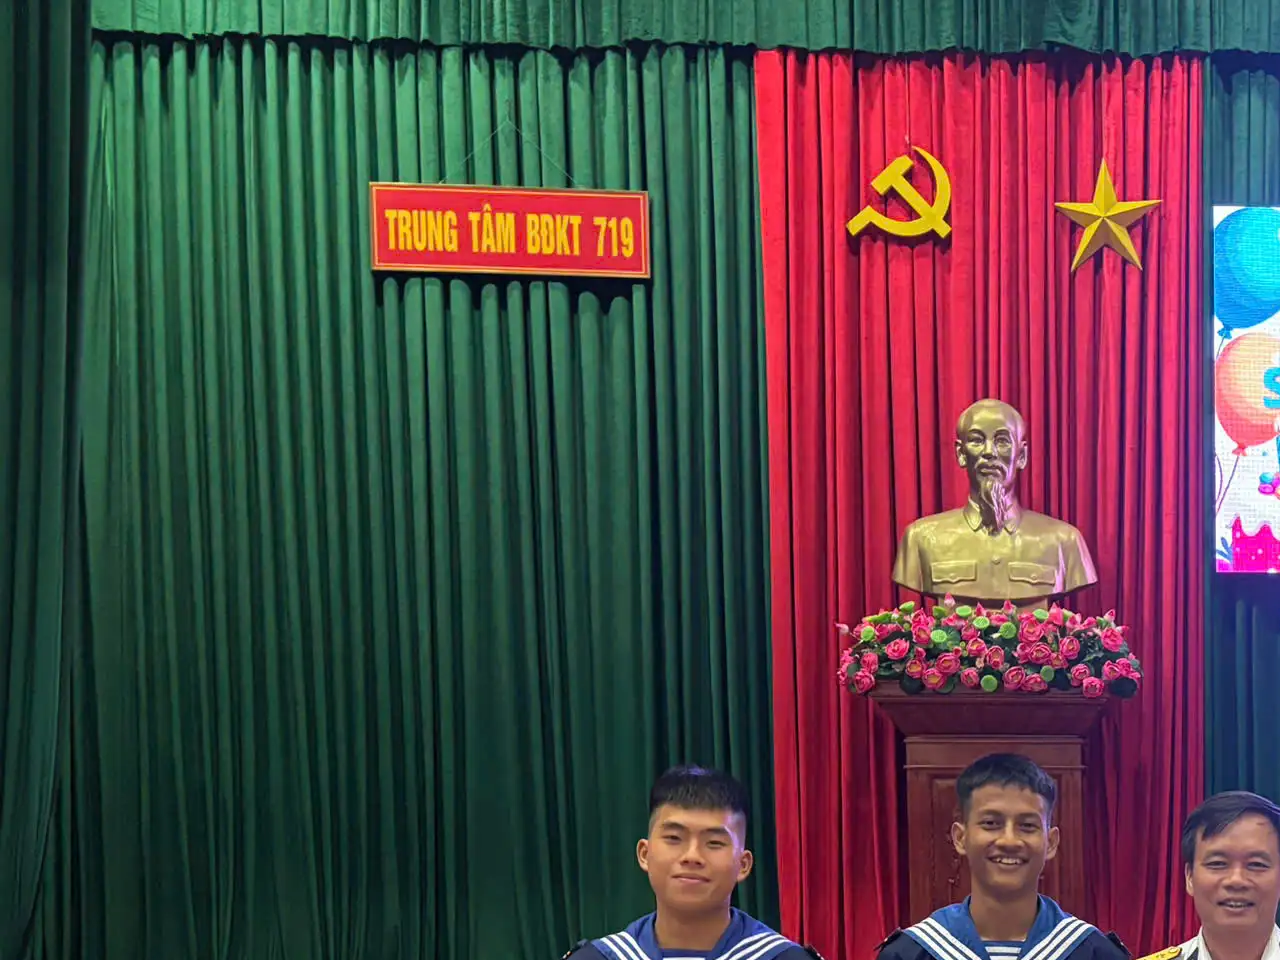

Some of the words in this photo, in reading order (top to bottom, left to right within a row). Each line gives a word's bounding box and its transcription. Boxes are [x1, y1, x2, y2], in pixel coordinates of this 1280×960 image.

[385, 209, 458, 252] TRUNG
[468, 203, 516, 253] TÂM
[526, 213, 582, 256] BĐKT
[593, 216, 634, 258] 719
